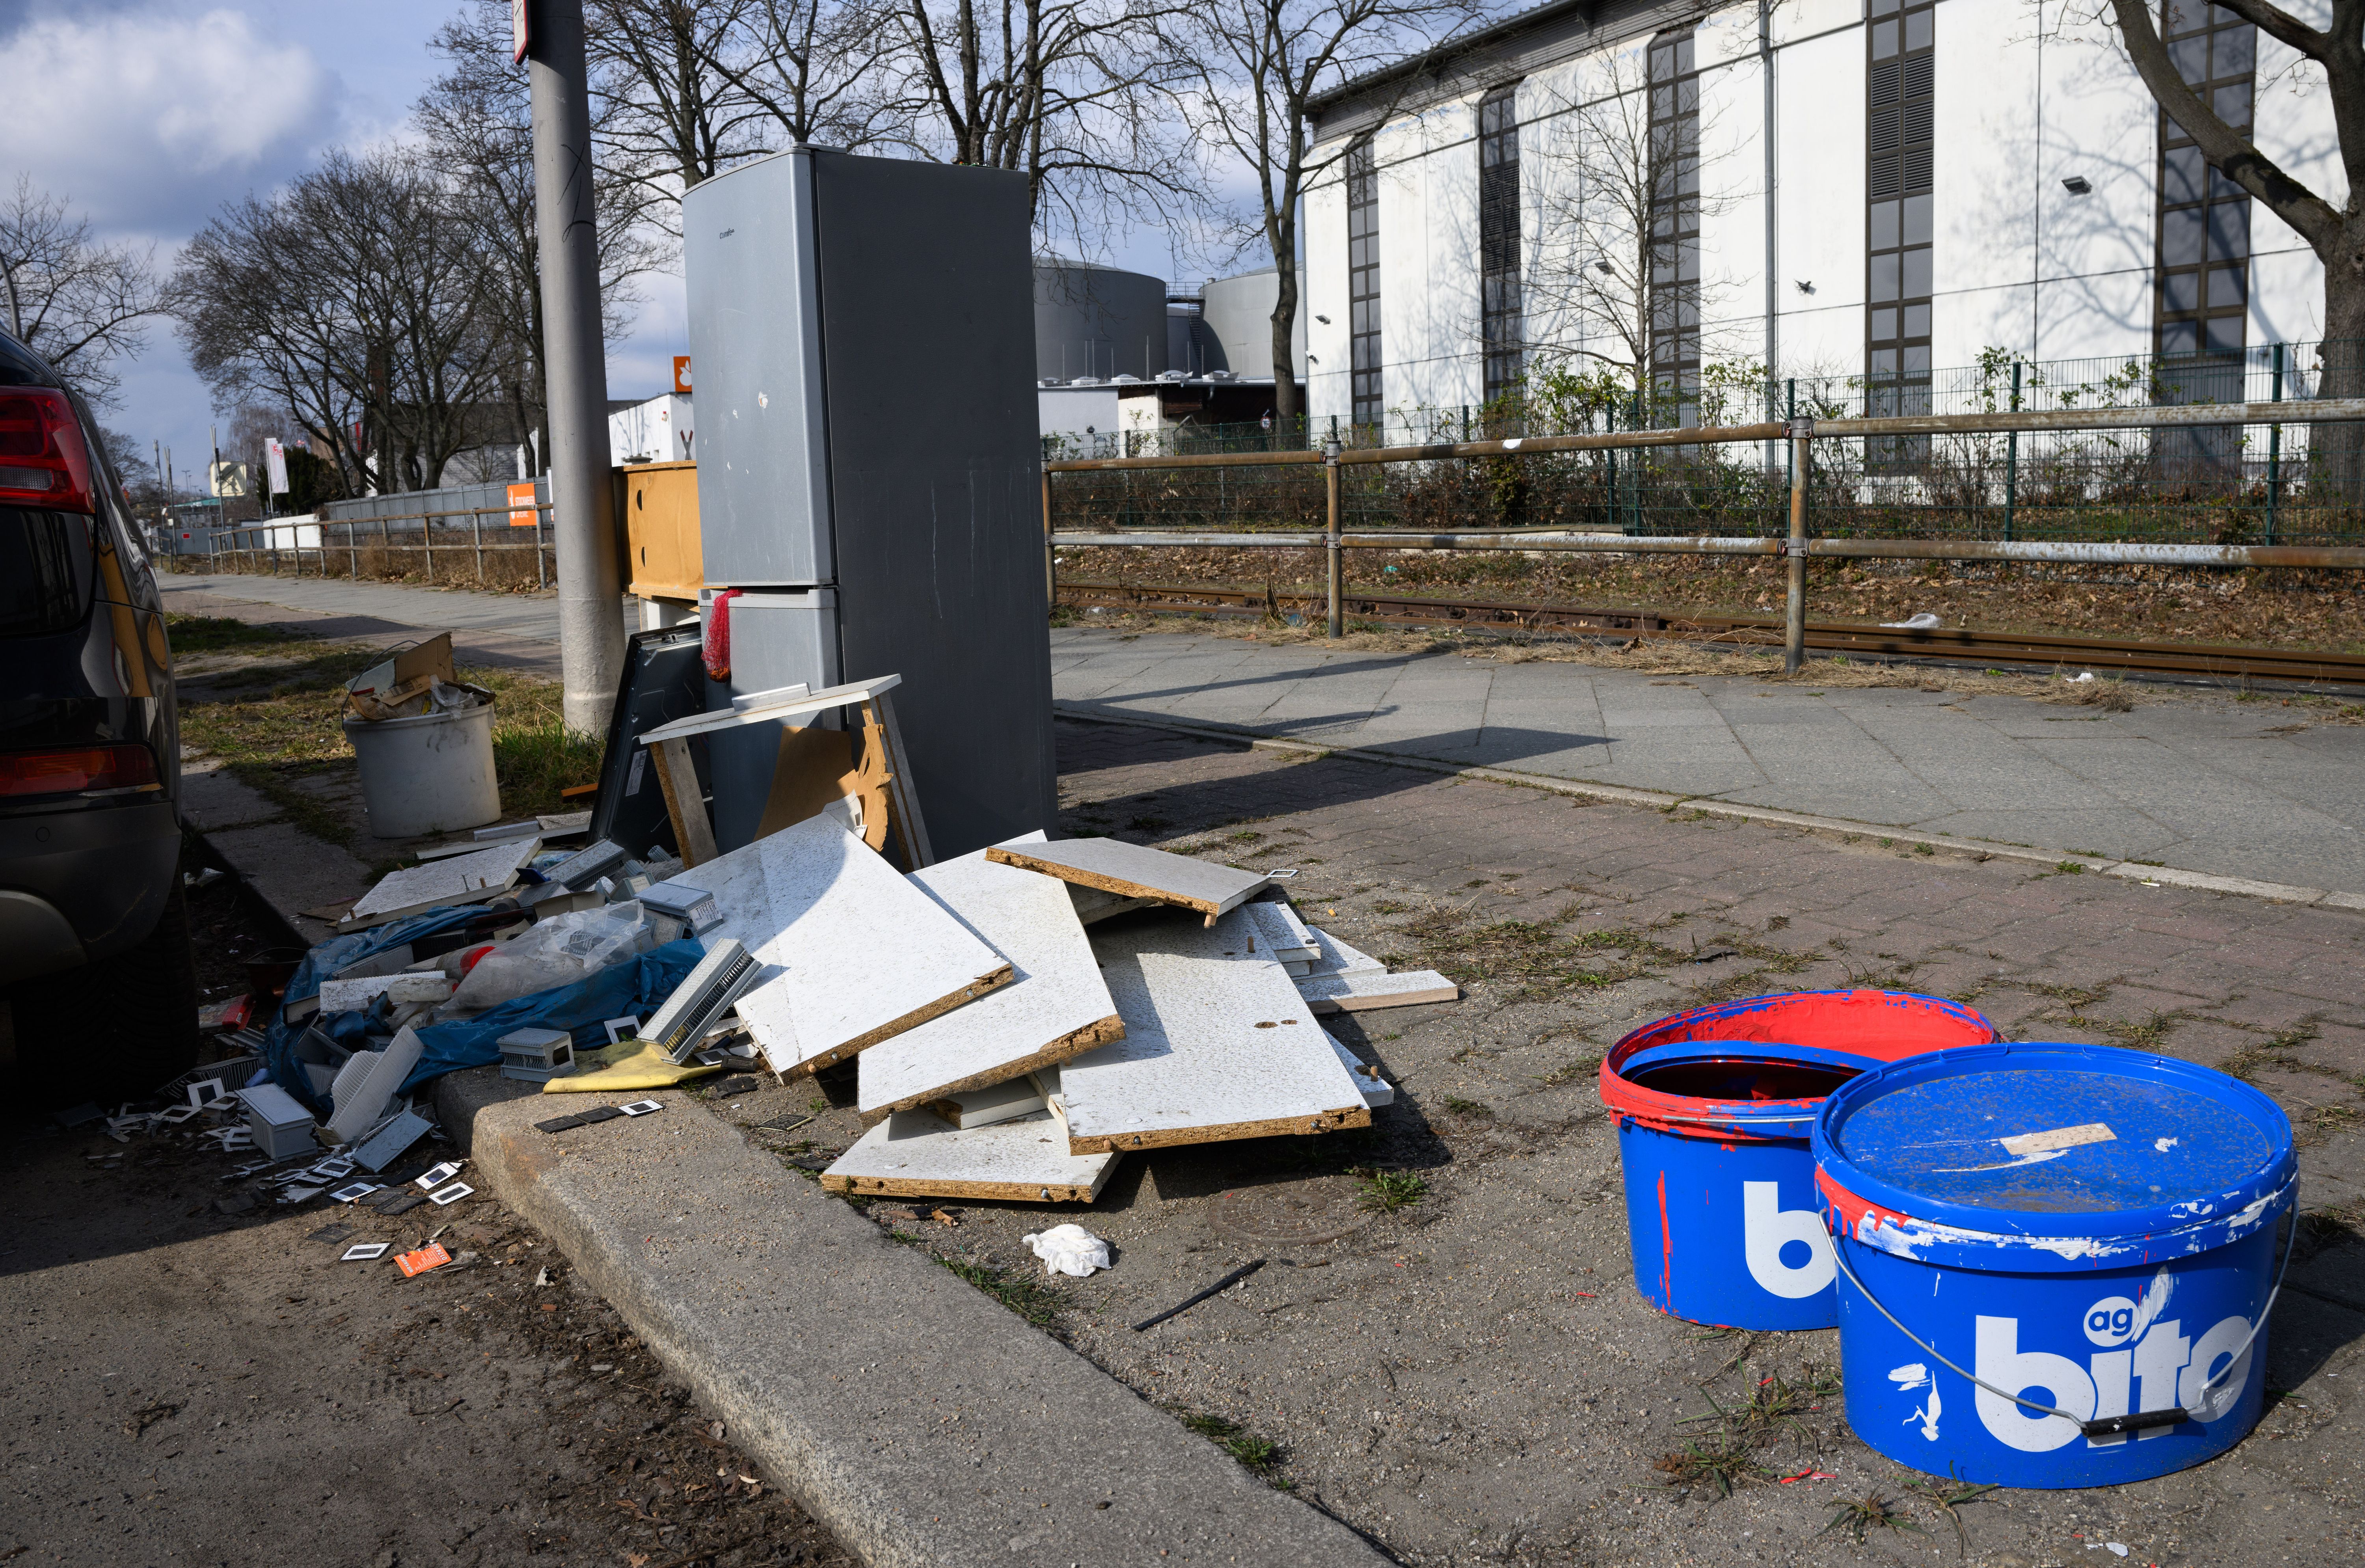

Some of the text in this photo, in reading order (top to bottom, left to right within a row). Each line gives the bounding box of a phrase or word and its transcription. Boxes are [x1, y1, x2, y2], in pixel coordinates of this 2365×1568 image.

[399, 1255, 410, 1266] KAUFEN
[436, 1249, 447, 1260] 0174
[2088, 1307, 2133, 1337] ag
[1976, 1315, 2253, 1452] bito
